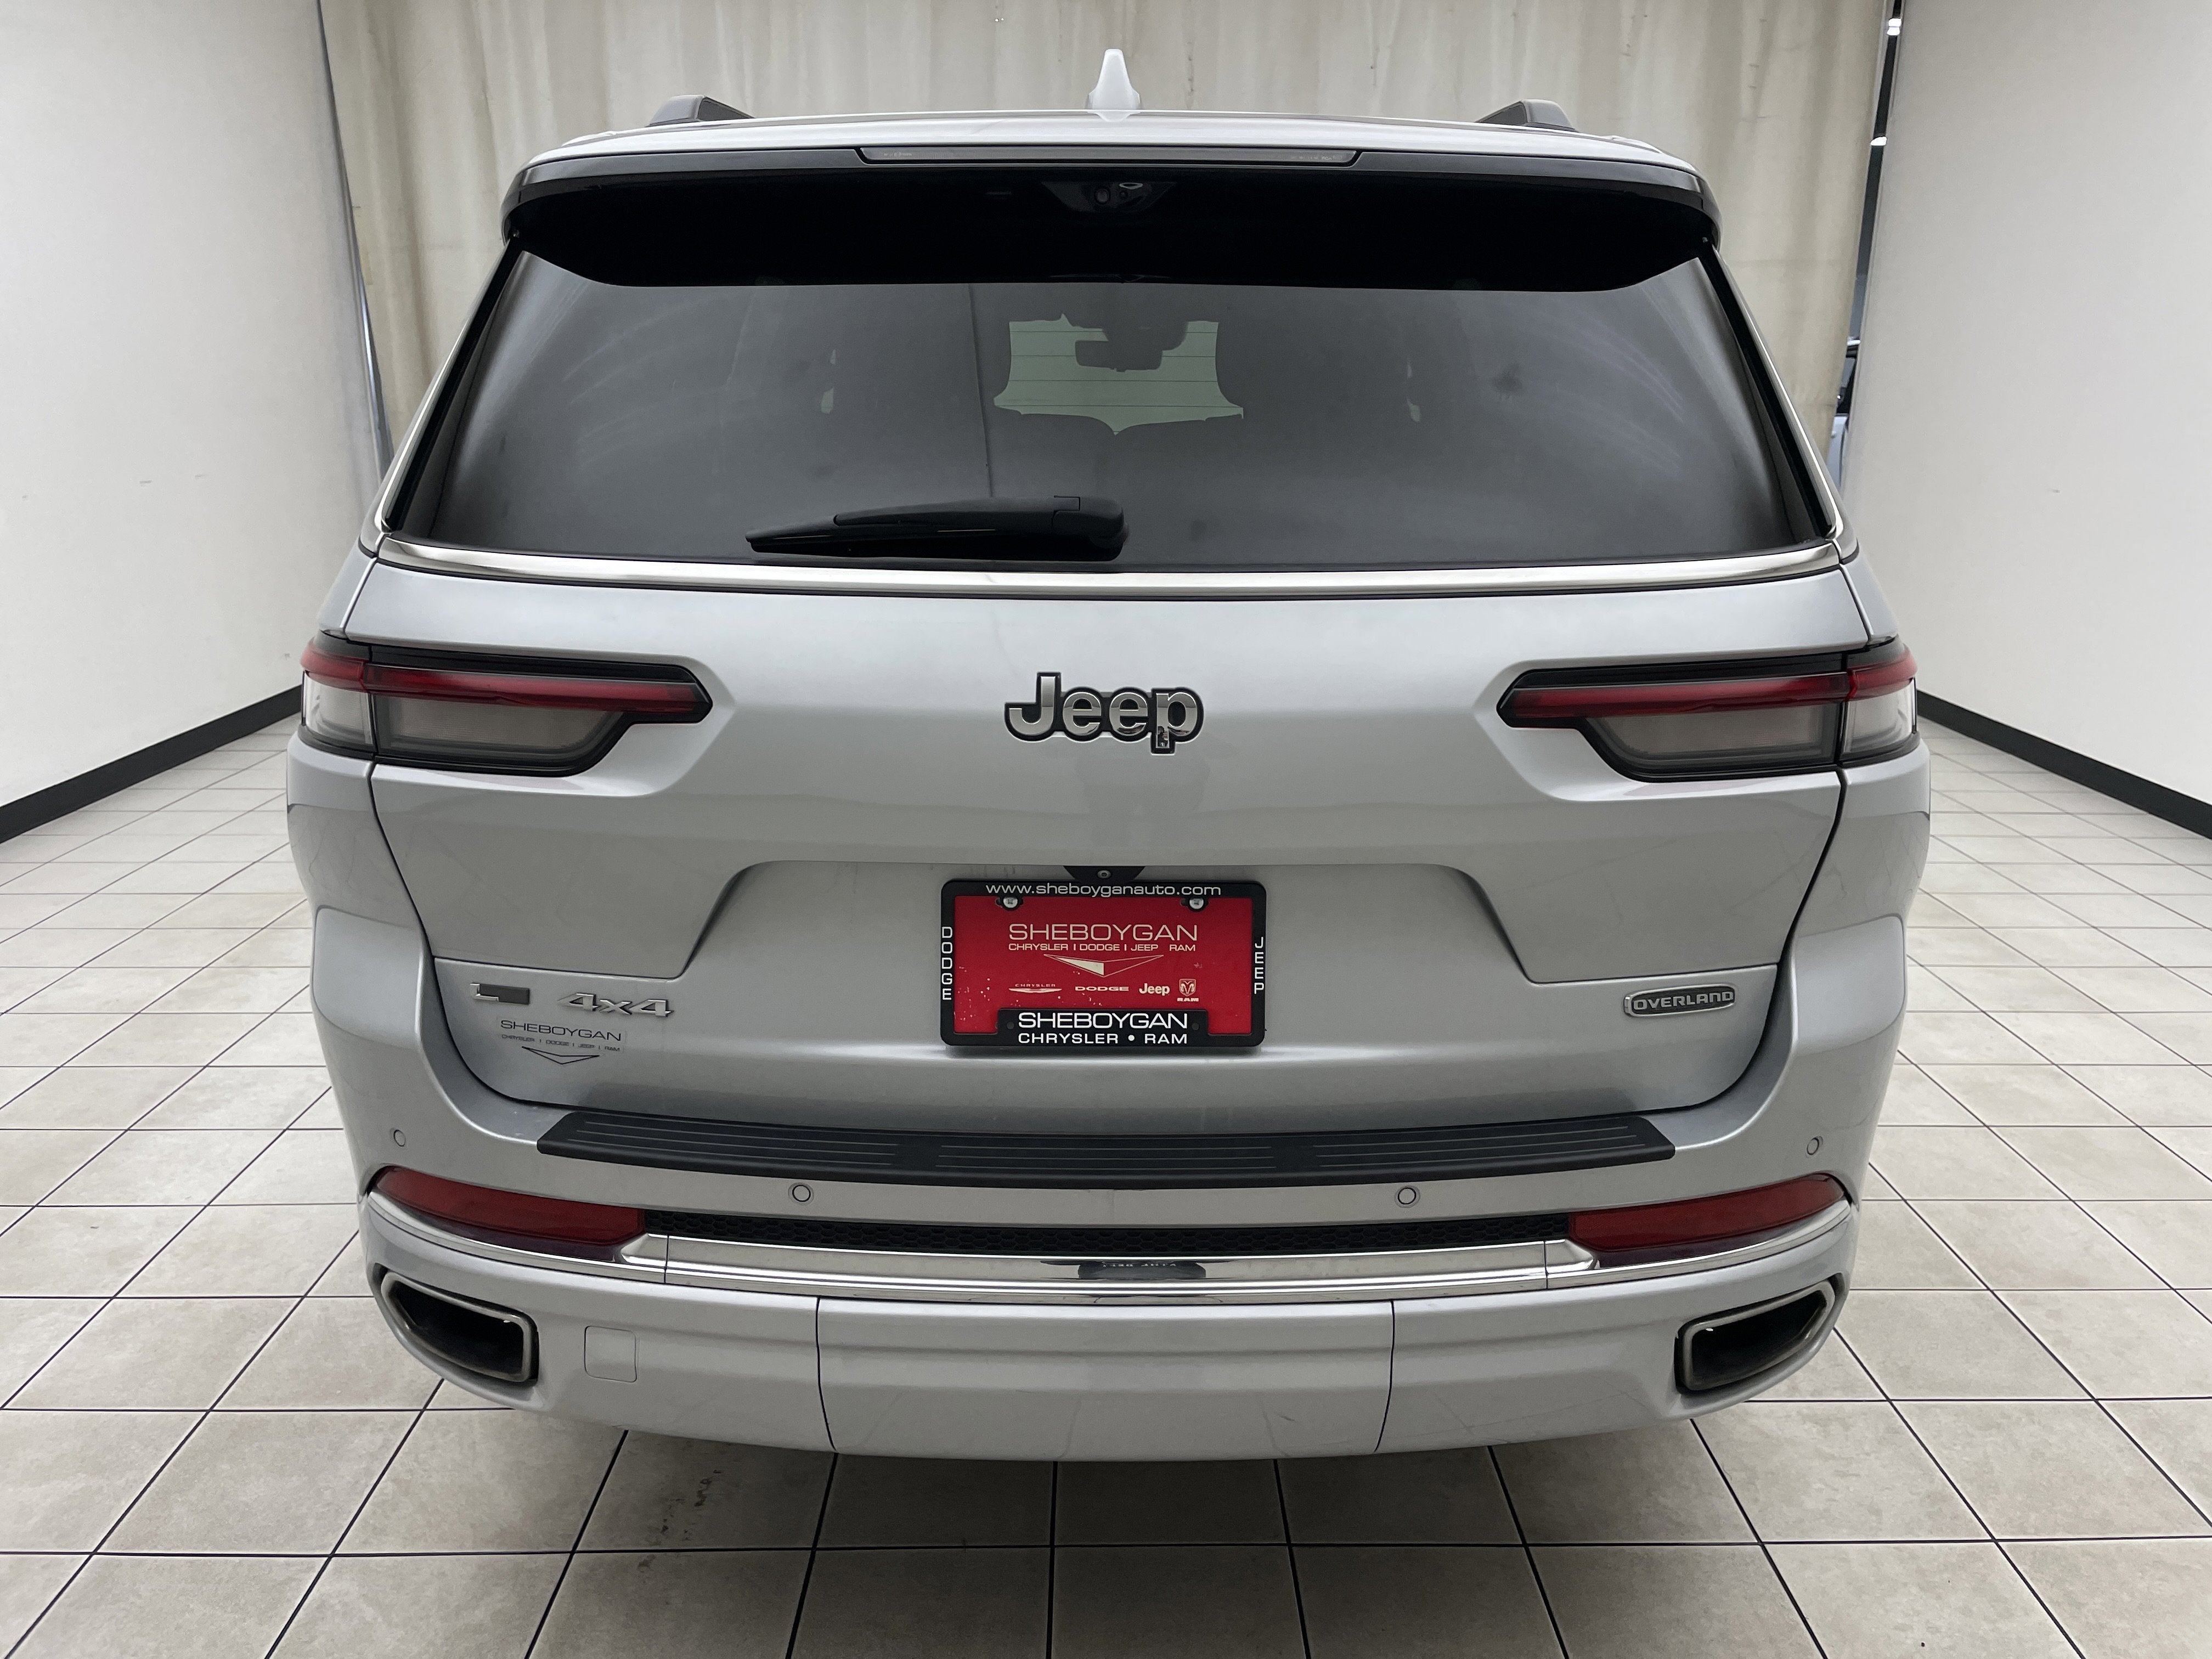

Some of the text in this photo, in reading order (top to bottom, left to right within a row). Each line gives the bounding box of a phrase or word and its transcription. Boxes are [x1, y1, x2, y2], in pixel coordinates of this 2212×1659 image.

[1005, 673, 1204, 754] Jeep
[986, 883, 1221, 898] www.sheboyganauto.com
[1009, 923, 1198, 941] SHEBOYGAN
[1079, 943, 1120, 951] DODGE
[941, 926, 953, 1000] DODGE
[1254, 936, 1265, 995] JEEP
[1138, 983, 1170, 996] Jeep
[557, 992, 674, 1017] 4x4
[1633, 991, 1734, 1011] OVERLAND
[500, 1019, 622, 1041] SHEBOYGAN
[1018, 1012, 1188, 1029] SHEBOYGAN
[1018, 1033, 1188, 1044] CHRYSLER RAM
